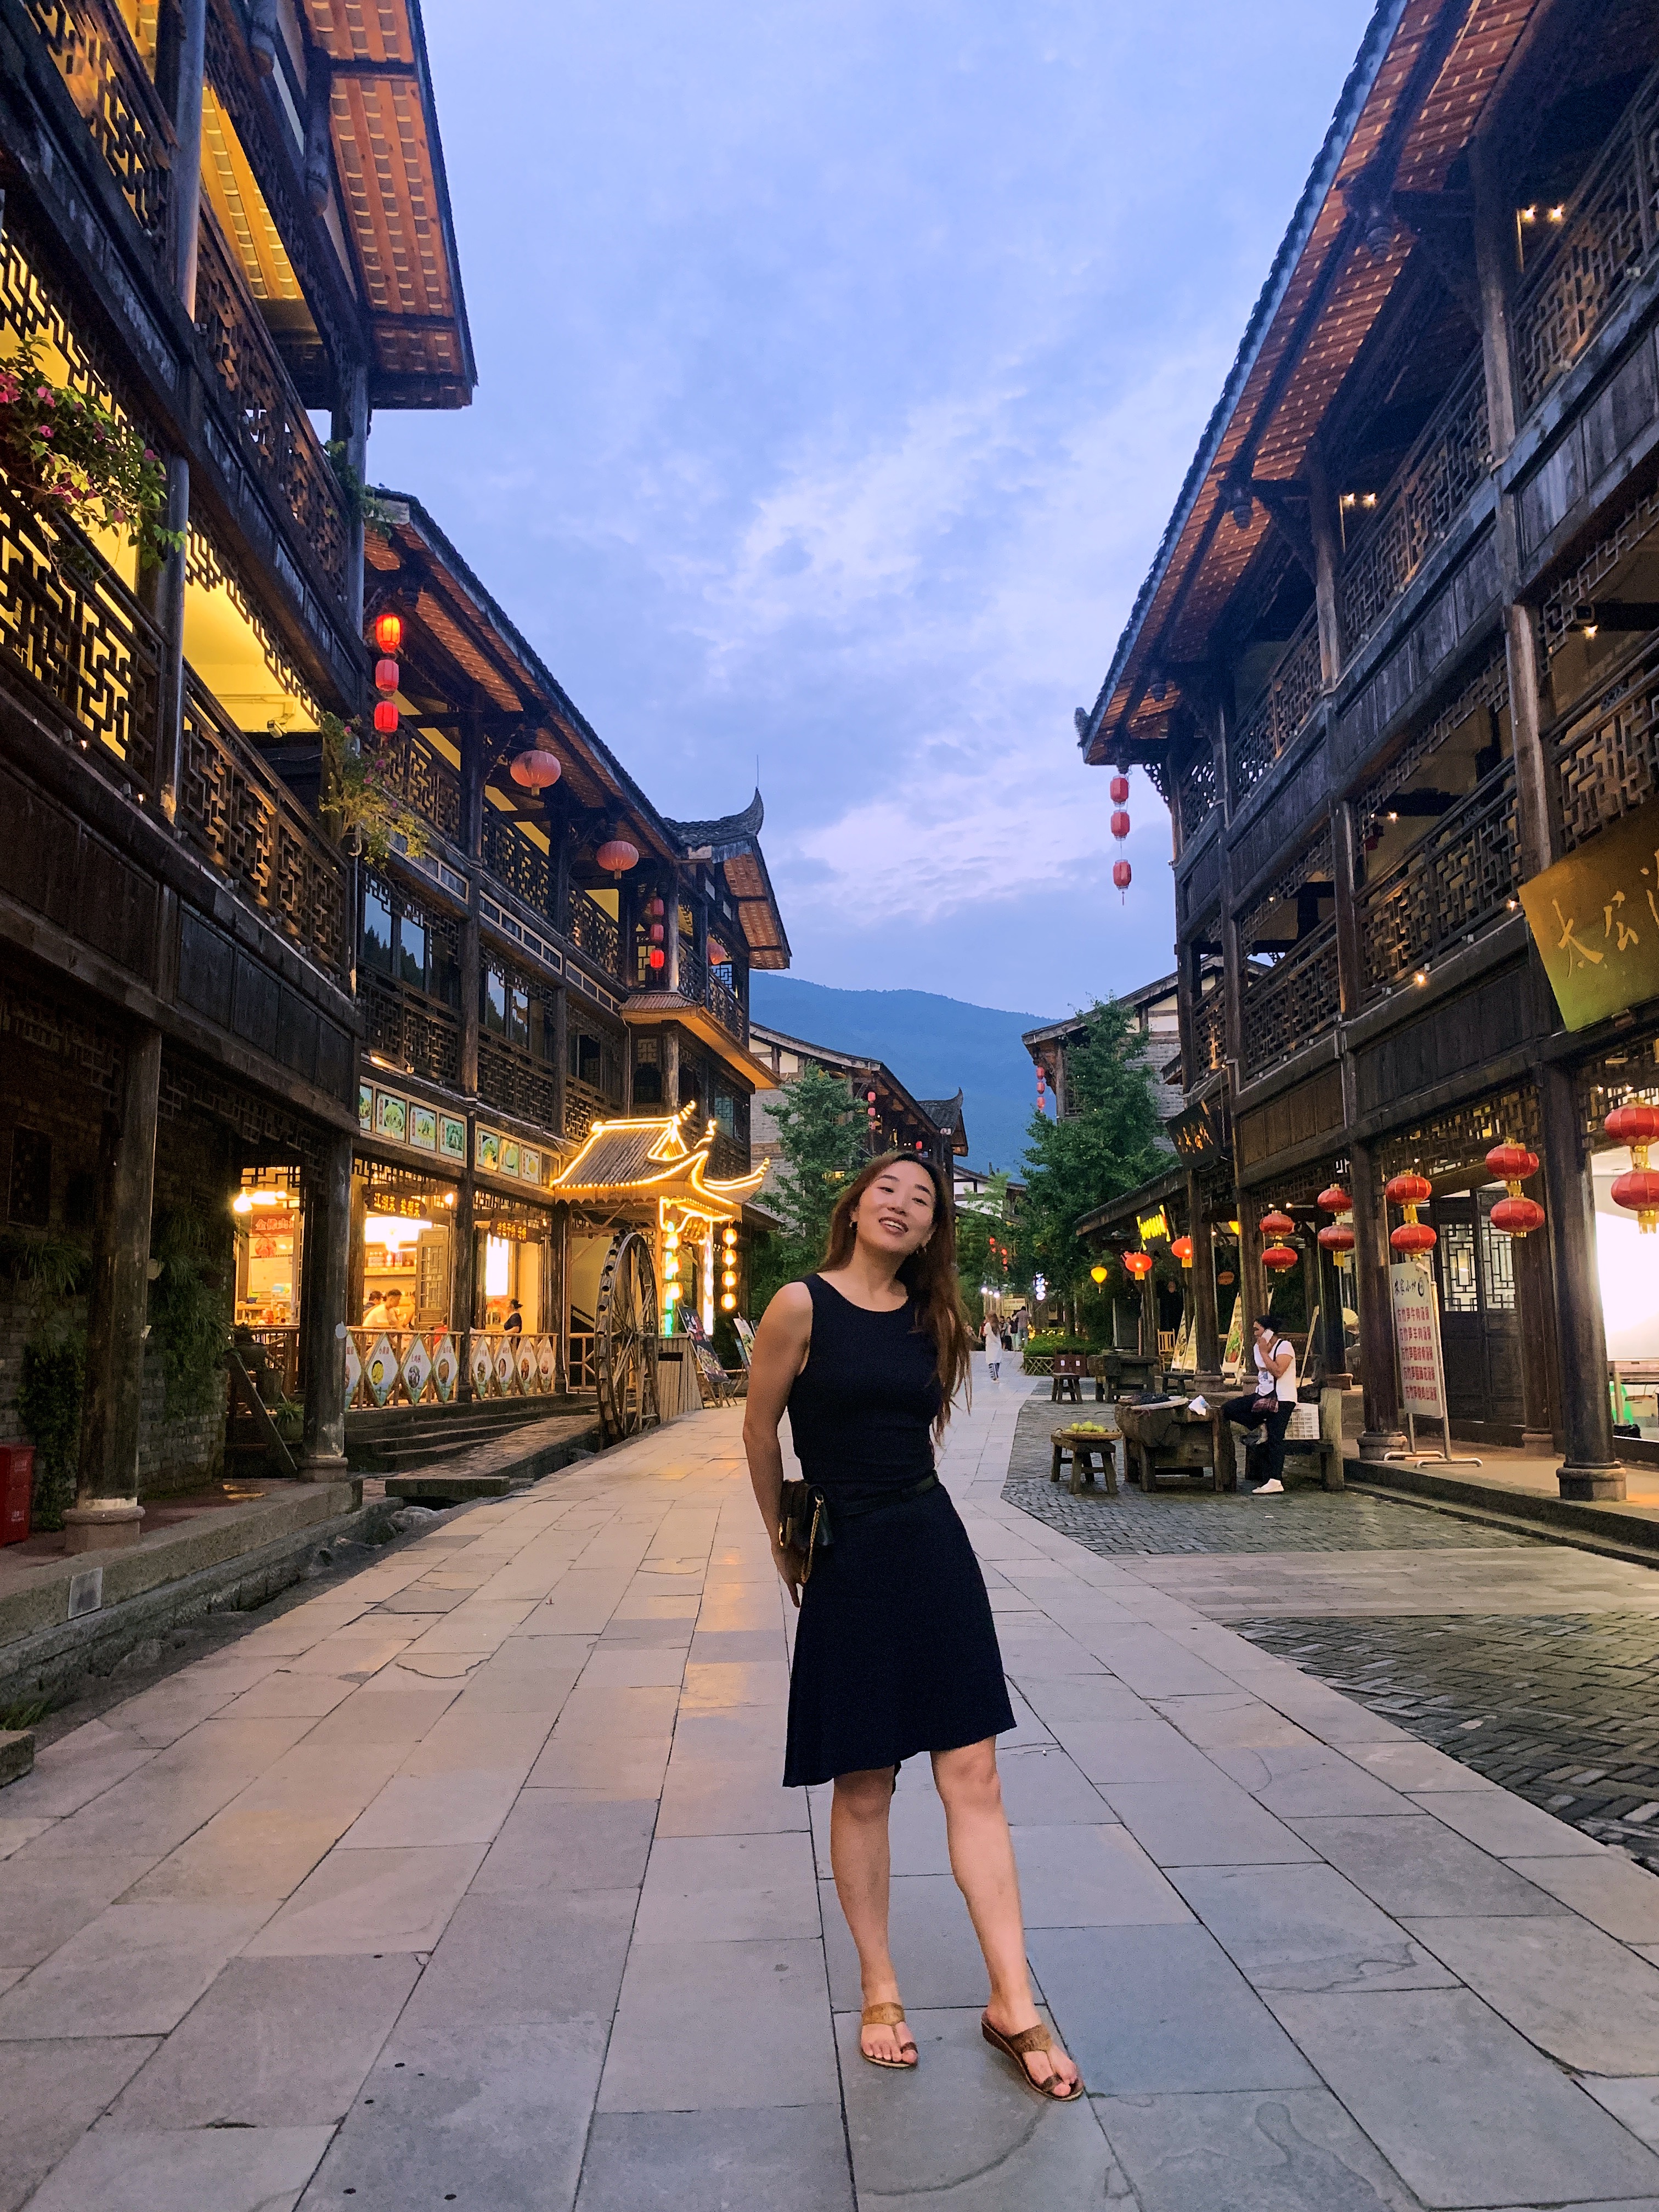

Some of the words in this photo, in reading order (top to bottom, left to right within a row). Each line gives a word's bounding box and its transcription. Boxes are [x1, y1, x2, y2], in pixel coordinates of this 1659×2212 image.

[1551, 849, 1659, 978] 太公
[374, 1192, 396, 1213] 江湖菜
